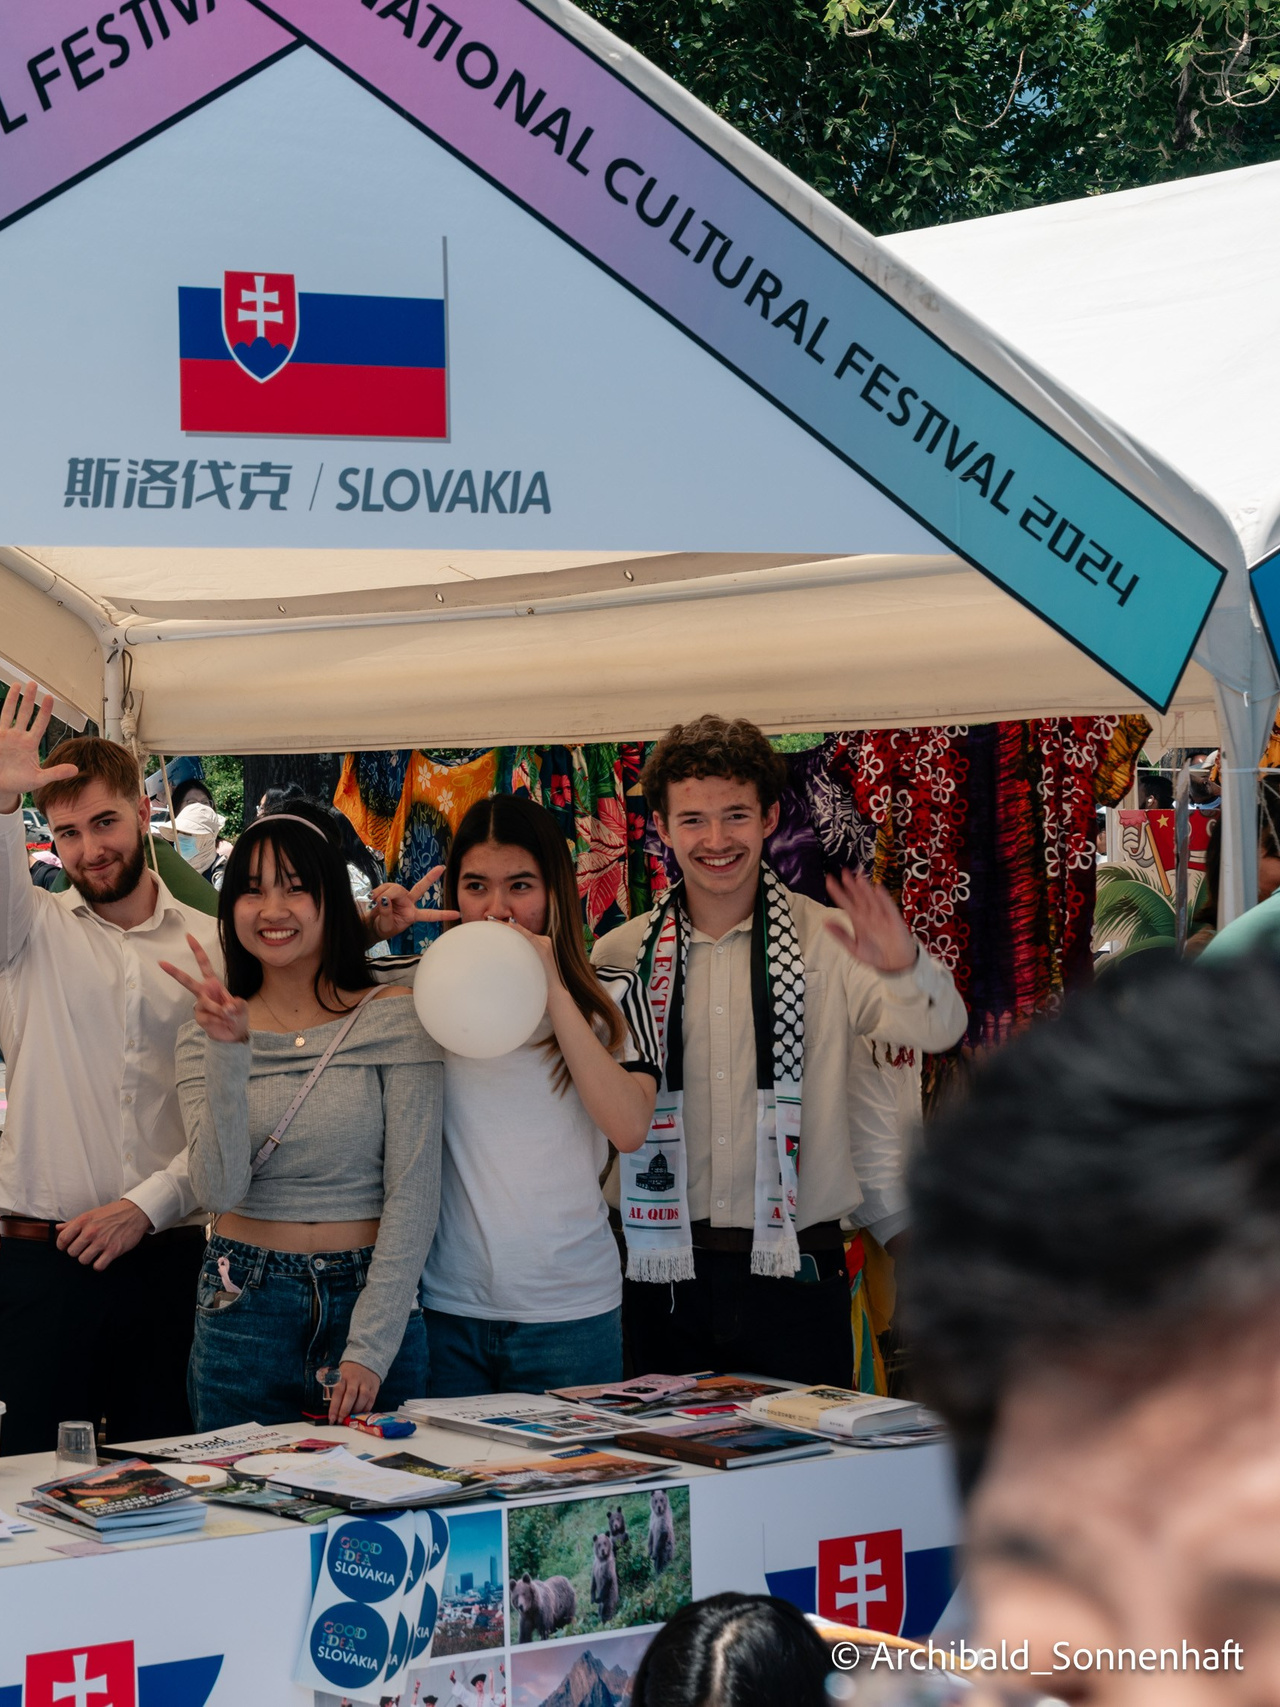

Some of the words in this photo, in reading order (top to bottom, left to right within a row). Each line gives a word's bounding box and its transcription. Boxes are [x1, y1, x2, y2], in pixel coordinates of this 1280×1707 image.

[26, 0, 216, 111] FESTIV
[604, 157, 835, 366] CULTURAL
[834, 342, 1019, 516] FESTIVAL
[1018, 495, 1141, 607] 2024
[63, 457, 293, 512] 斯洛伐克
[335, 467, 552, 515] SLOVAKIA
[628, 1207, 644, 1220] AL
[647, 1207, 679, 1221] QUDS
[180, 1435, 227, 1451] Road
[340, 1536, 382, 1555] GOOD
[337, 1549, 372, 1566] IDEA
[334, 1560, 396, 1587] SLOVAKIA
[320, 1632, 356, 1652] IDEA
[323, 1621, 368, 1640] GOOD
[317, 1645, 379, 1672] SLOVAKIA
